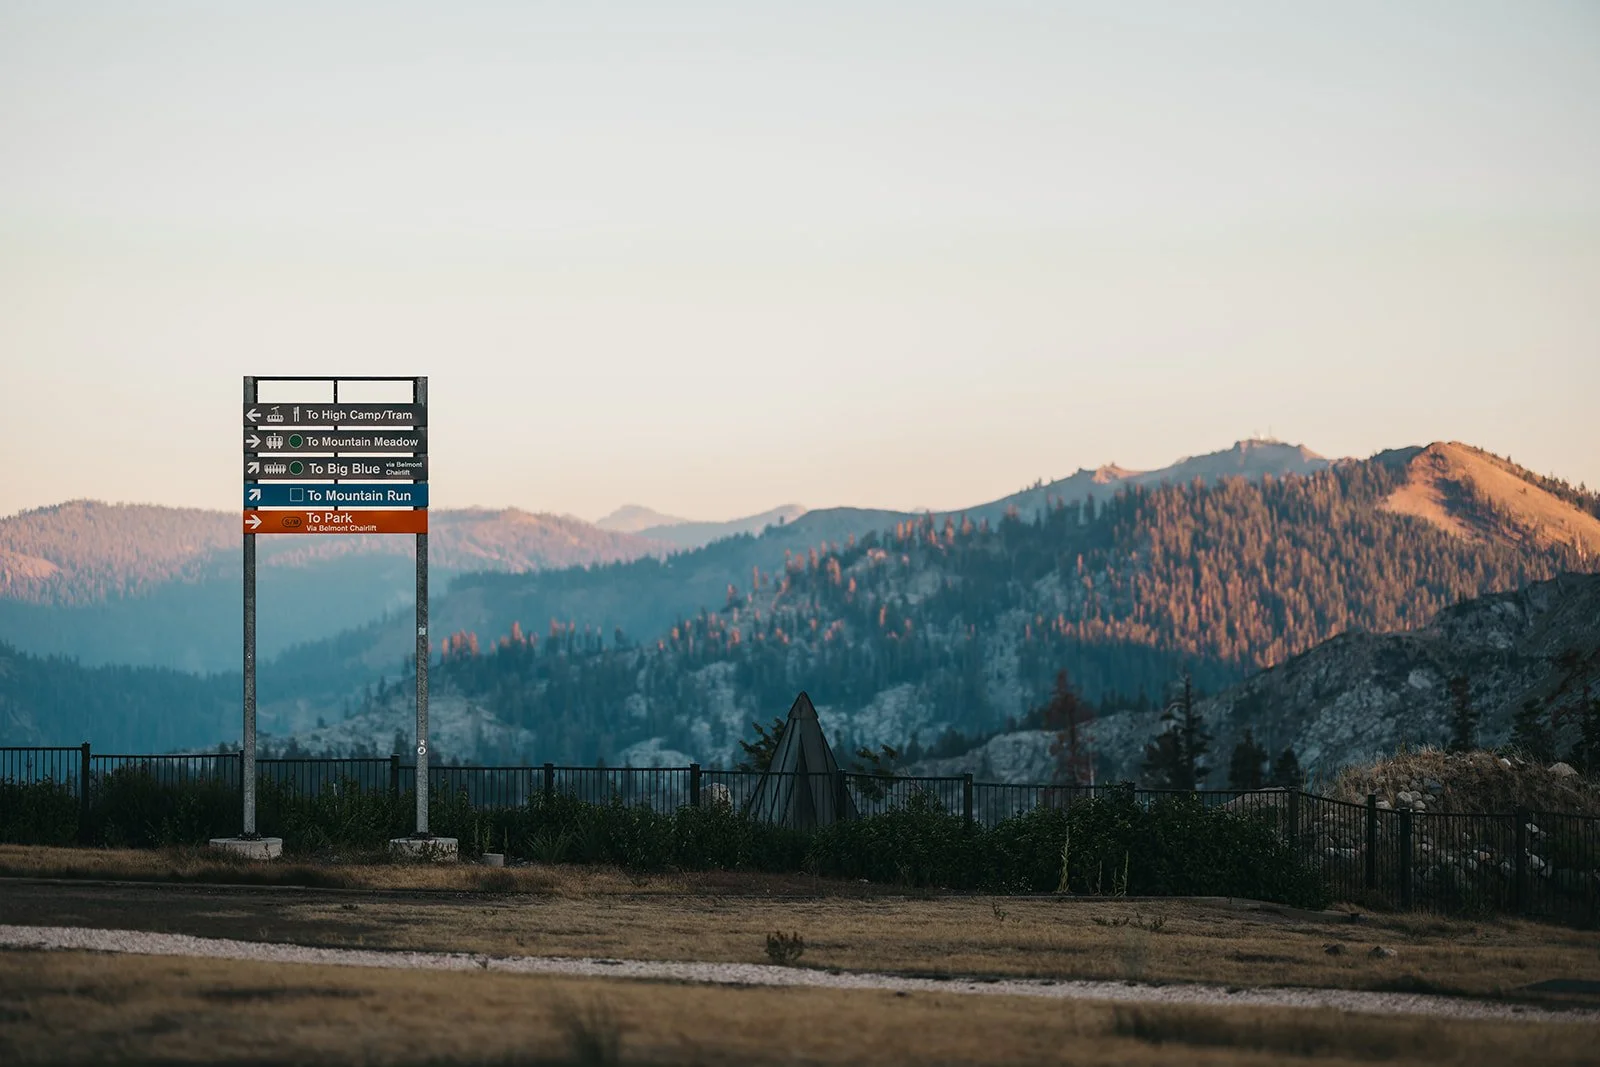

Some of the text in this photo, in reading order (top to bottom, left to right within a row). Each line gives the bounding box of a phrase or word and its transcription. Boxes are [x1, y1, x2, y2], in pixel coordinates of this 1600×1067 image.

[306, 409, 413, 422] To High Camp/Tram
[306, 436, 419, 447] To Mountain Meadow
[309, 463, 381, 476] To Big Blue
[307, 490, 412, 501] To Mountain Run
[306, 513, 353, 524] To Park
